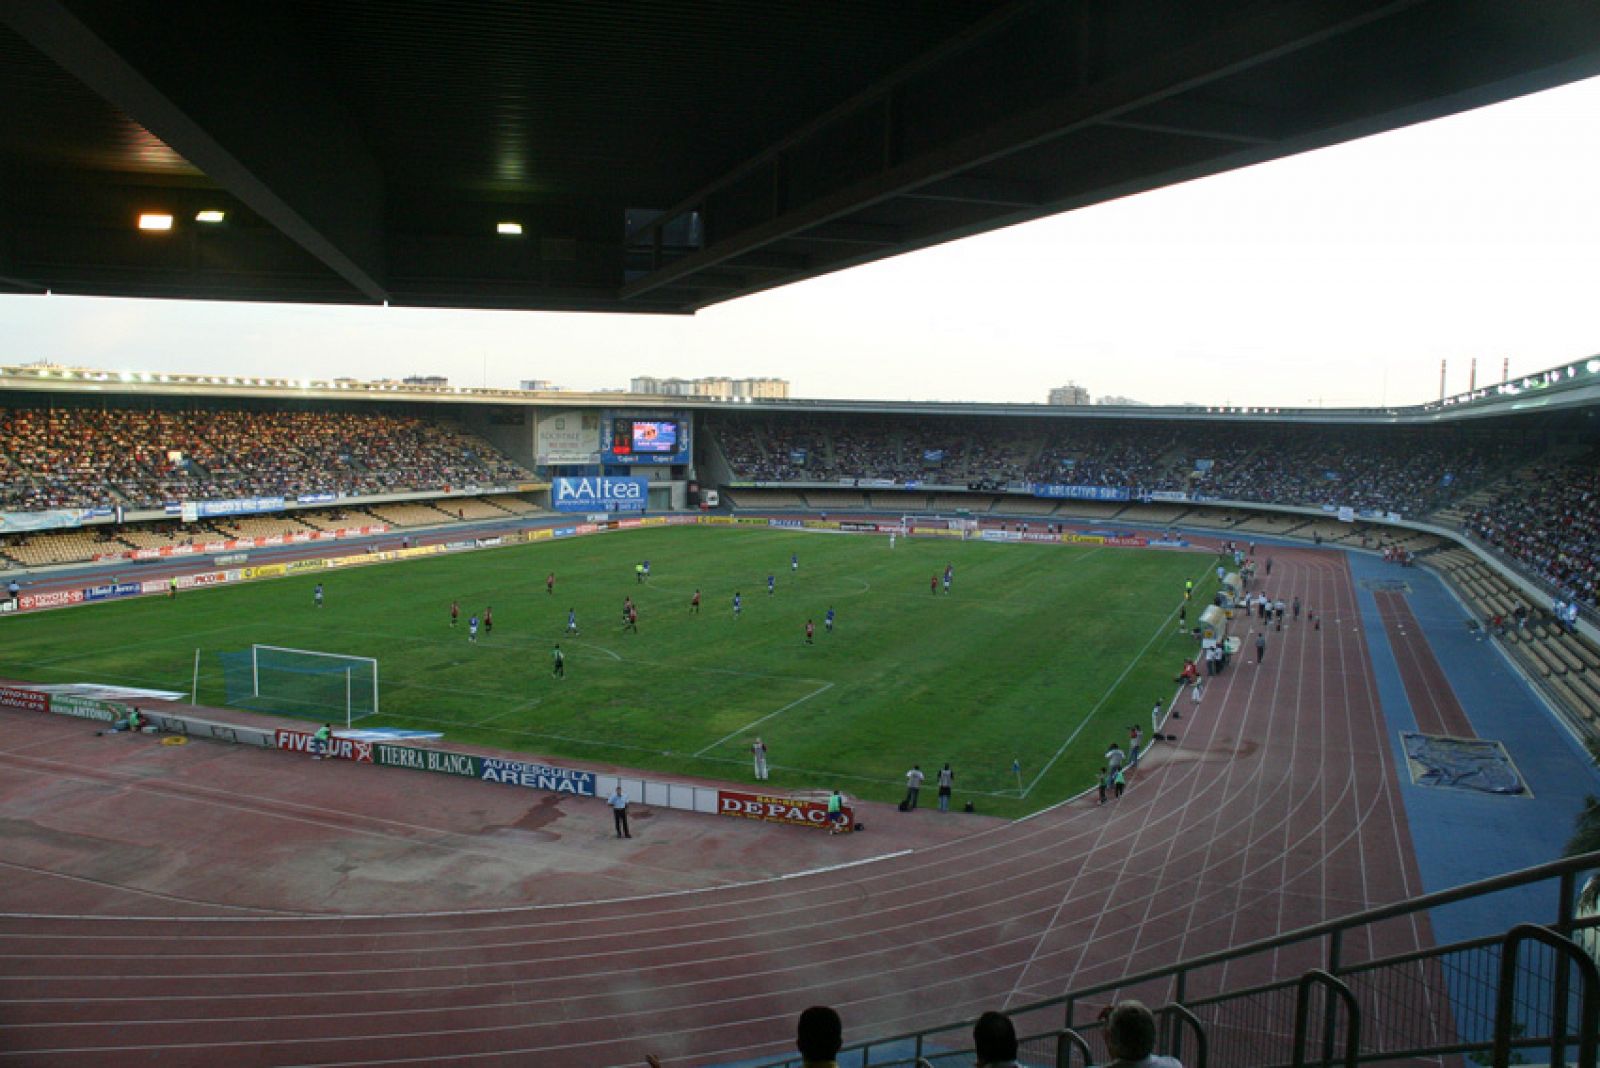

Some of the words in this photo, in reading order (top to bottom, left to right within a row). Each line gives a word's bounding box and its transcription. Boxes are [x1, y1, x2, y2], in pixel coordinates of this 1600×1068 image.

[558, 477, 640, 500] AAltea
[33, 589, 69, 602] TOYOTA
[379, 745, 425, 769] TIERRA
[427, 756, 475, 777] BLANCA
[483, 759, 590, 783] AUTOESCUELA
[481, 767, 593, 796] ARENAL
